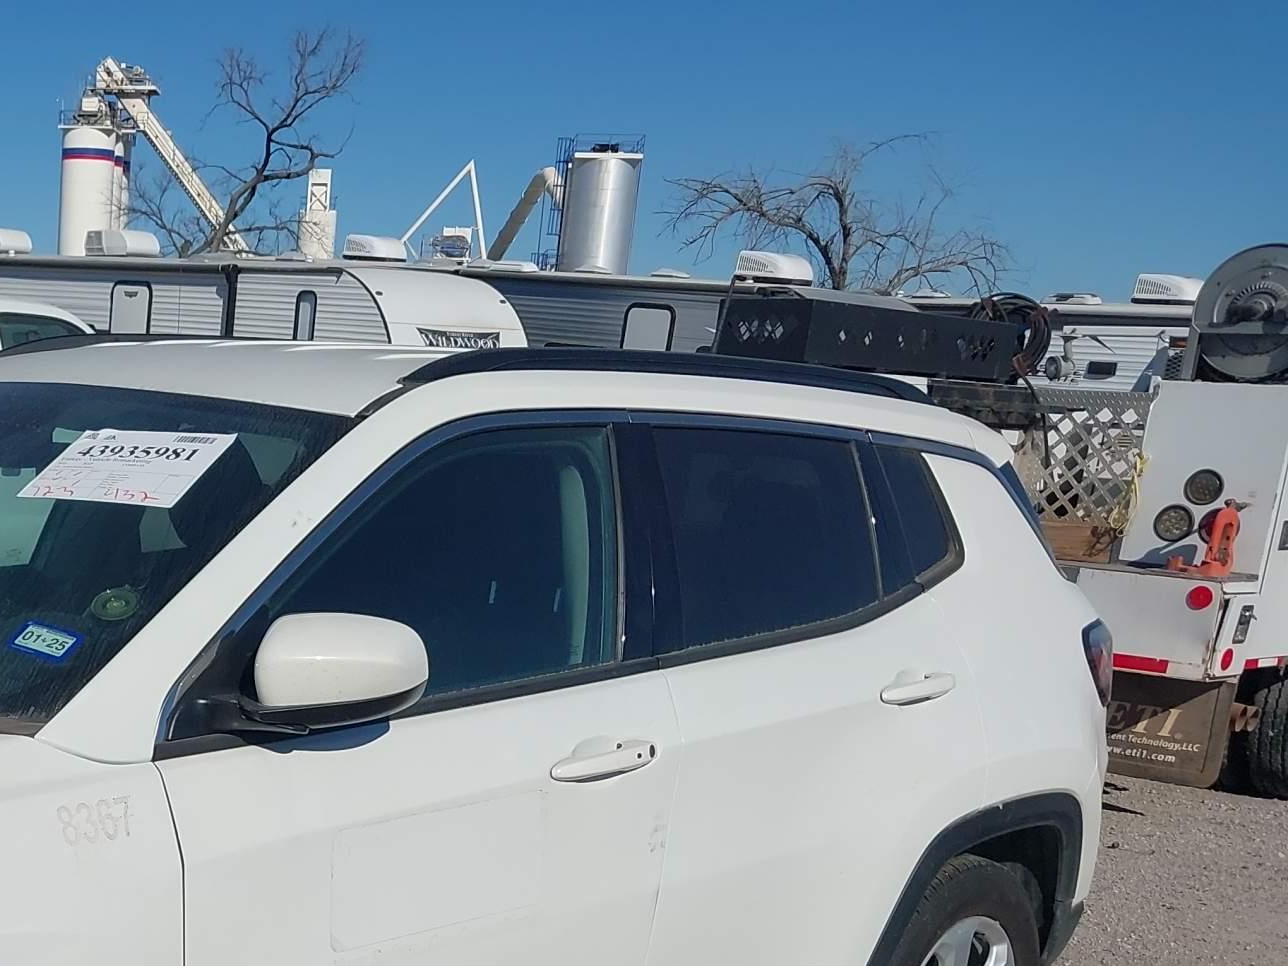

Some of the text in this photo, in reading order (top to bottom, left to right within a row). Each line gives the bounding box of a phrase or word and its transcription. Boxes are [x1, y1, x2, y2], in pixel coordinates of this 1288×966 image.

[421, 334, 500, 349] WILDWOOD
[77, 444, 200, 462] 43935981
[56, 795, 131, 847] 8367
